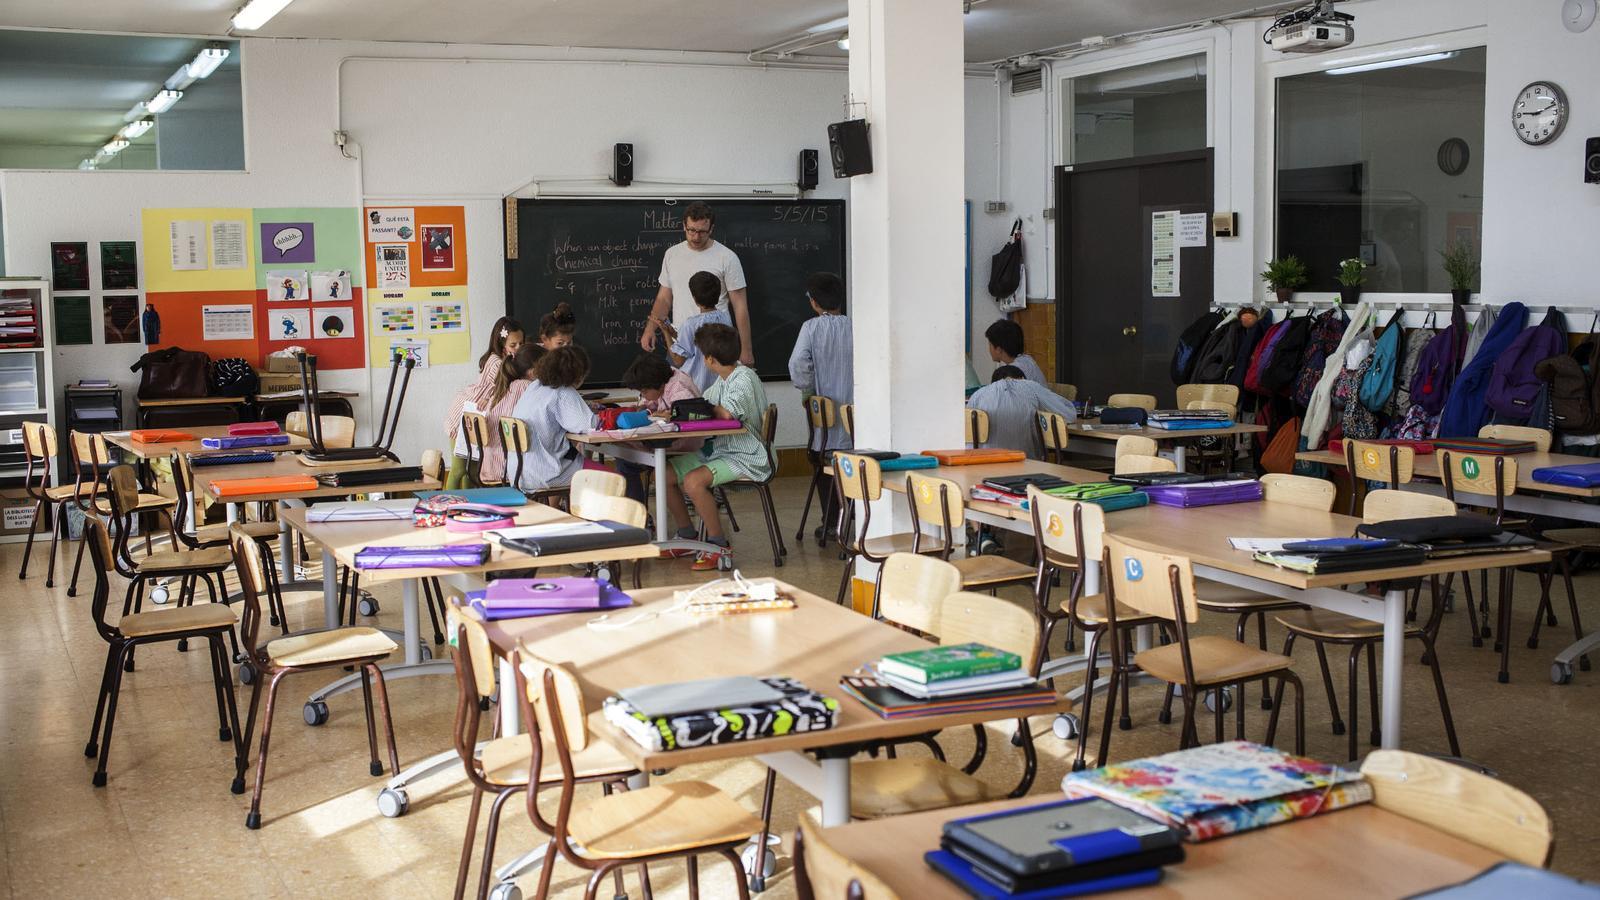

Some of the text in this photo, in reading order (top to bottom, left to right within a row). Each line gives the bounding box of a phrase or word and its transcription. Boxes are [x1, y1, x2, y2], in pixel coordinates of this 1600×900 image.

[643, 209, 683, 230] Matter
[770, 205, 828, 223] 5/5/15
[602, 239, 628, 255] object
[555, 254, 644, 272] Chemical change
[596, 274, 626, 292] Fruit
[598, 296, 618, 309] Milk
[601, 315, 622, 329] Iron
[603, 330, 631, 345] Wood
[1367, 452, 1376, 464] S
[1465, 461, 1475, 474] M
[1128, 558, 1138, 576] C
